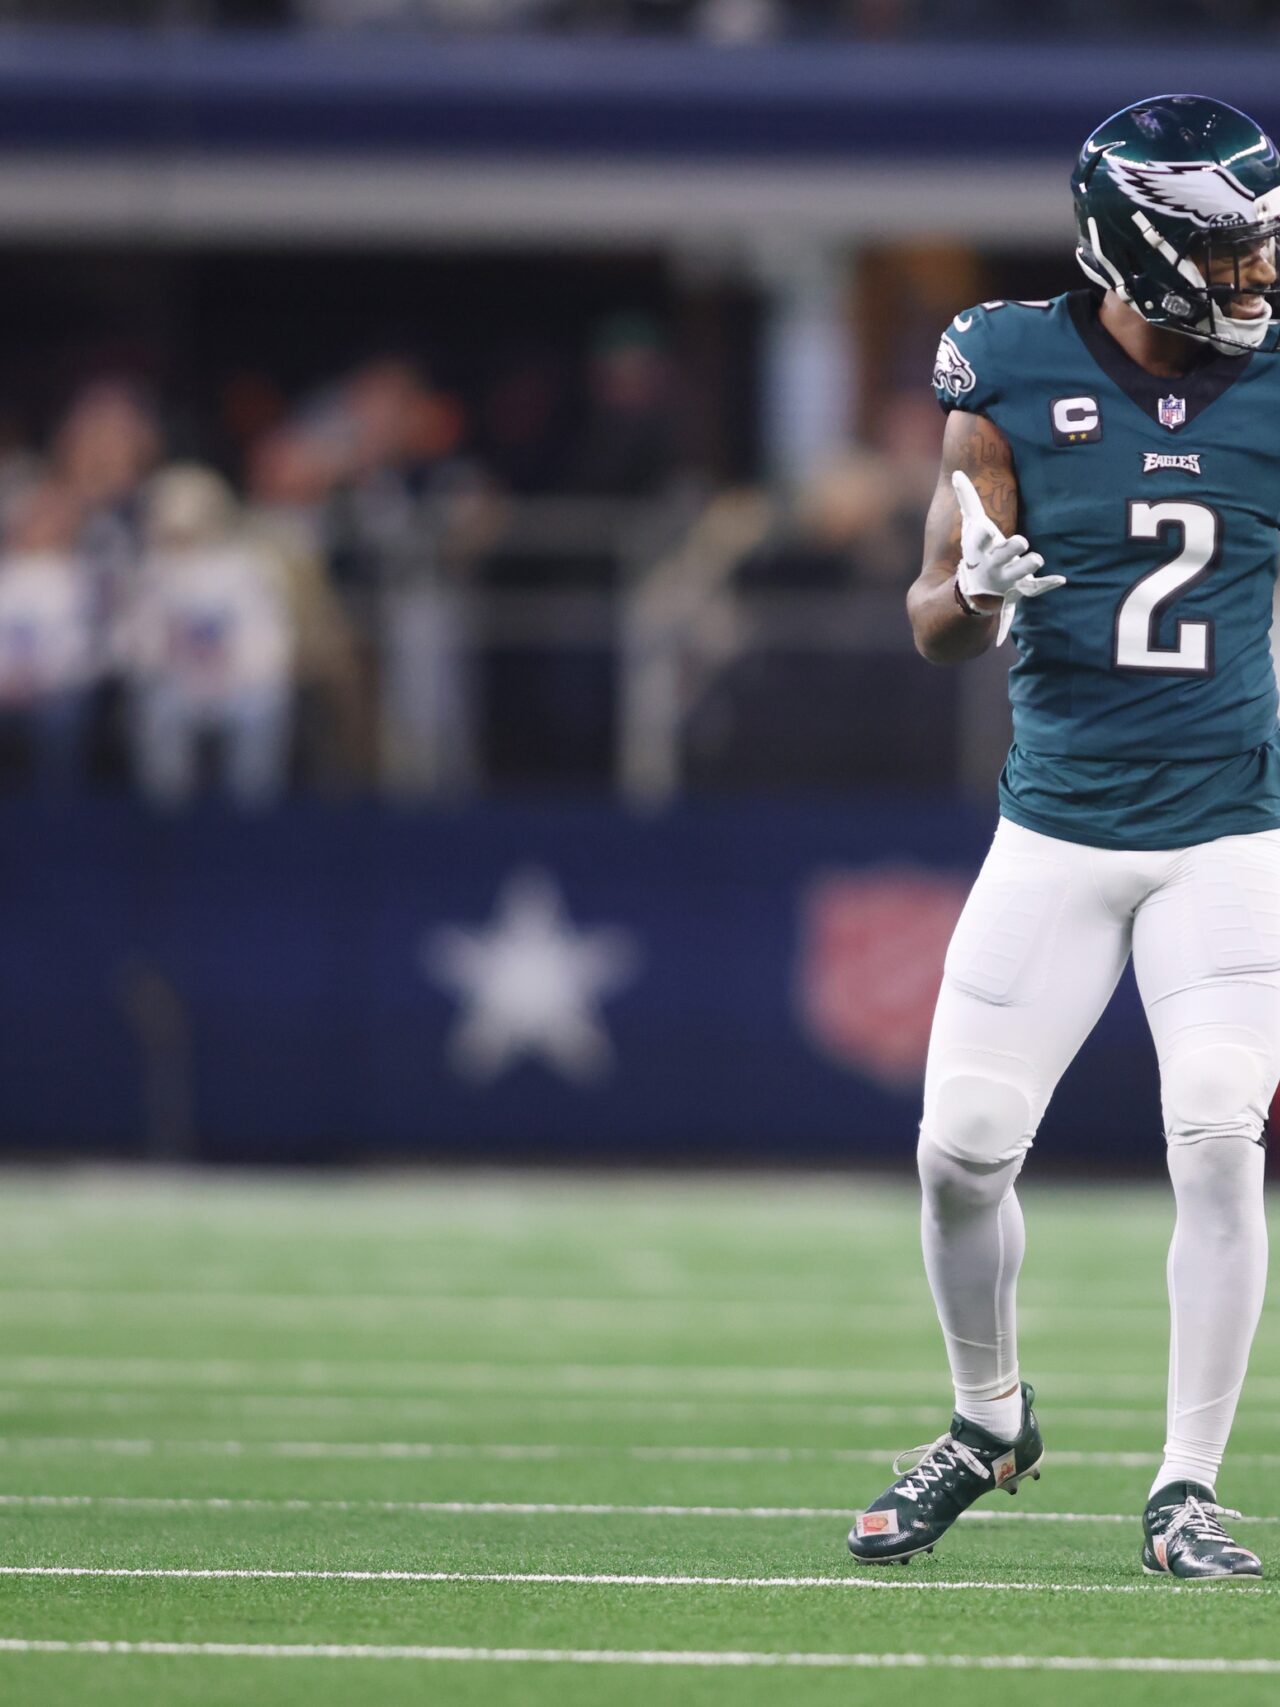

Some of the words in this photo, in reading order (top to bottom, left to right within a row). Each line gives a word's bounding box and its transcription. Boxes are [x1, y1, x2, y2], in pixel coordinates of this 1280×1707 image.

[1053, 397, 1098, 433] C
[1143, 452, 1201, 474] EAGLES
[1115, 501, 1217, 671] 2
